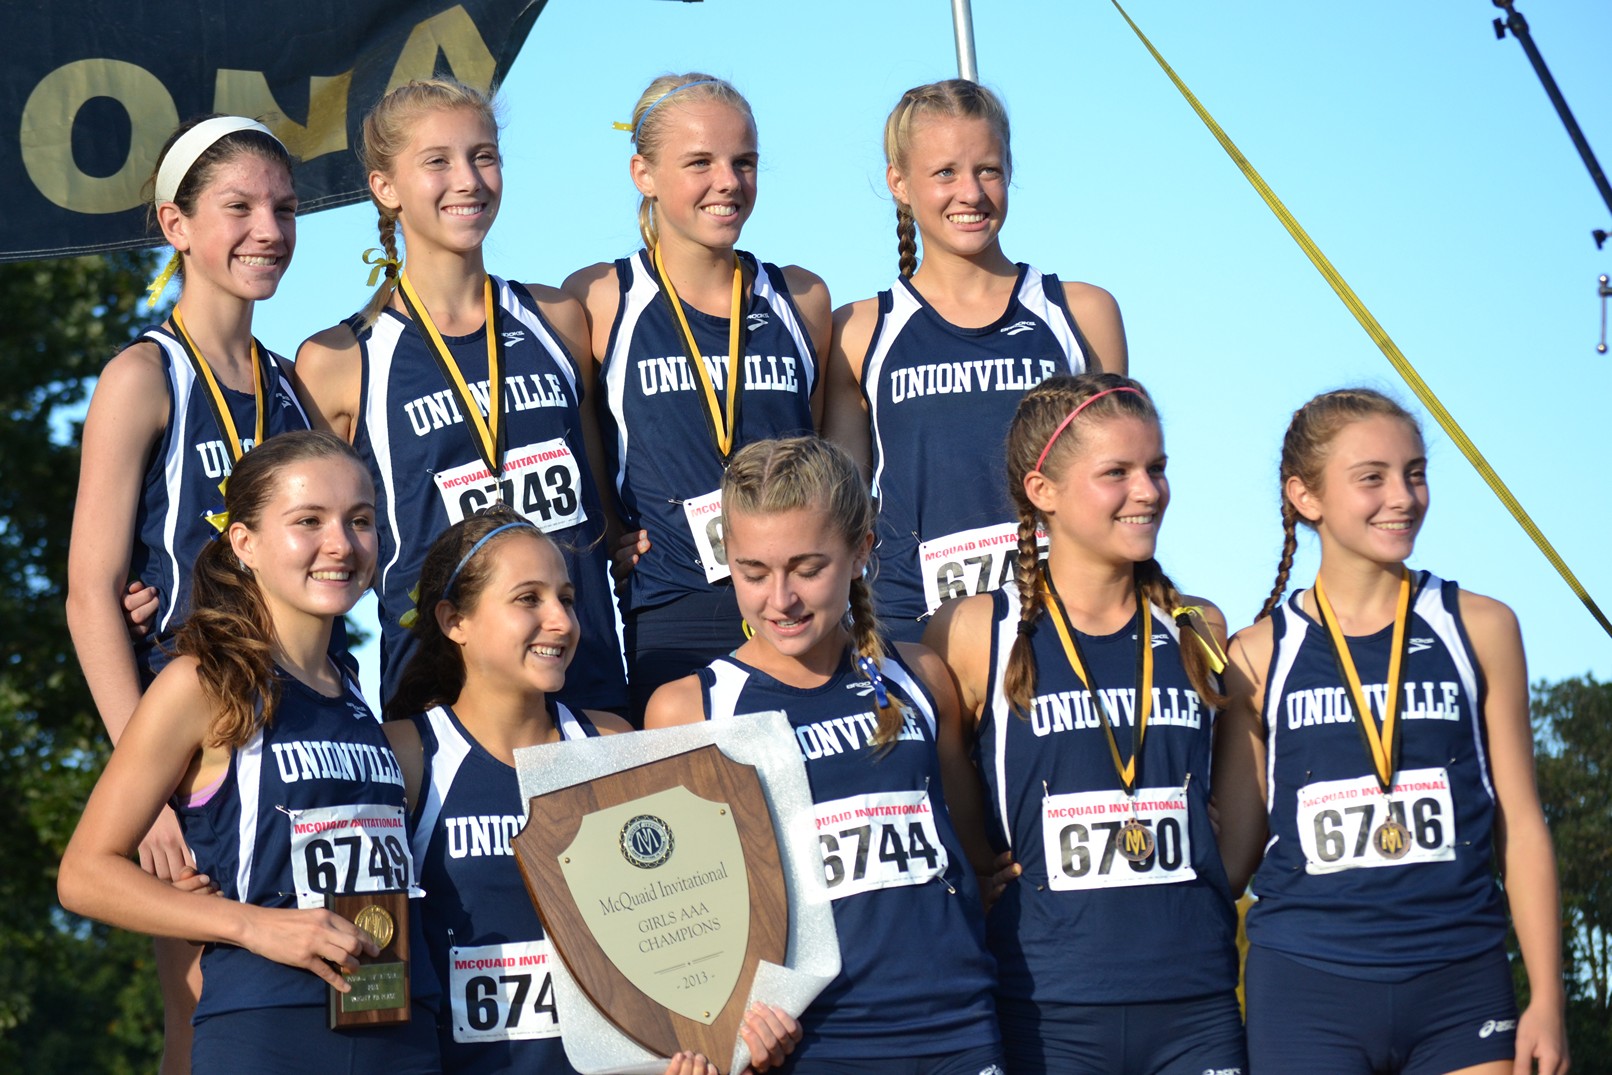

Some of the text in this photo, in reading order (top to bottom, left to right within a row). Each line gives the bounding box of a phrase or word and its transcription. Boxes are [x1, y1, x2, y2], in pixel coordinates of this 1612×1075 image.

[925, 541, 976, 561] MCQUAID
[855, 804, 930, 820] INVITATIONAL
[1047, 804, 1106, 818] MCQUAID
[294, 820, 348, 835] MCQUAID
[305, 835, 409, 896] 6749
[599, 861, 728, 917] McQuaid Invitational
[638, 902, 710, 934] GIRLS AAA
[638, 917, 721, 953] CHAMPIONS
[455, 957, 516, 971] MCQUAID
